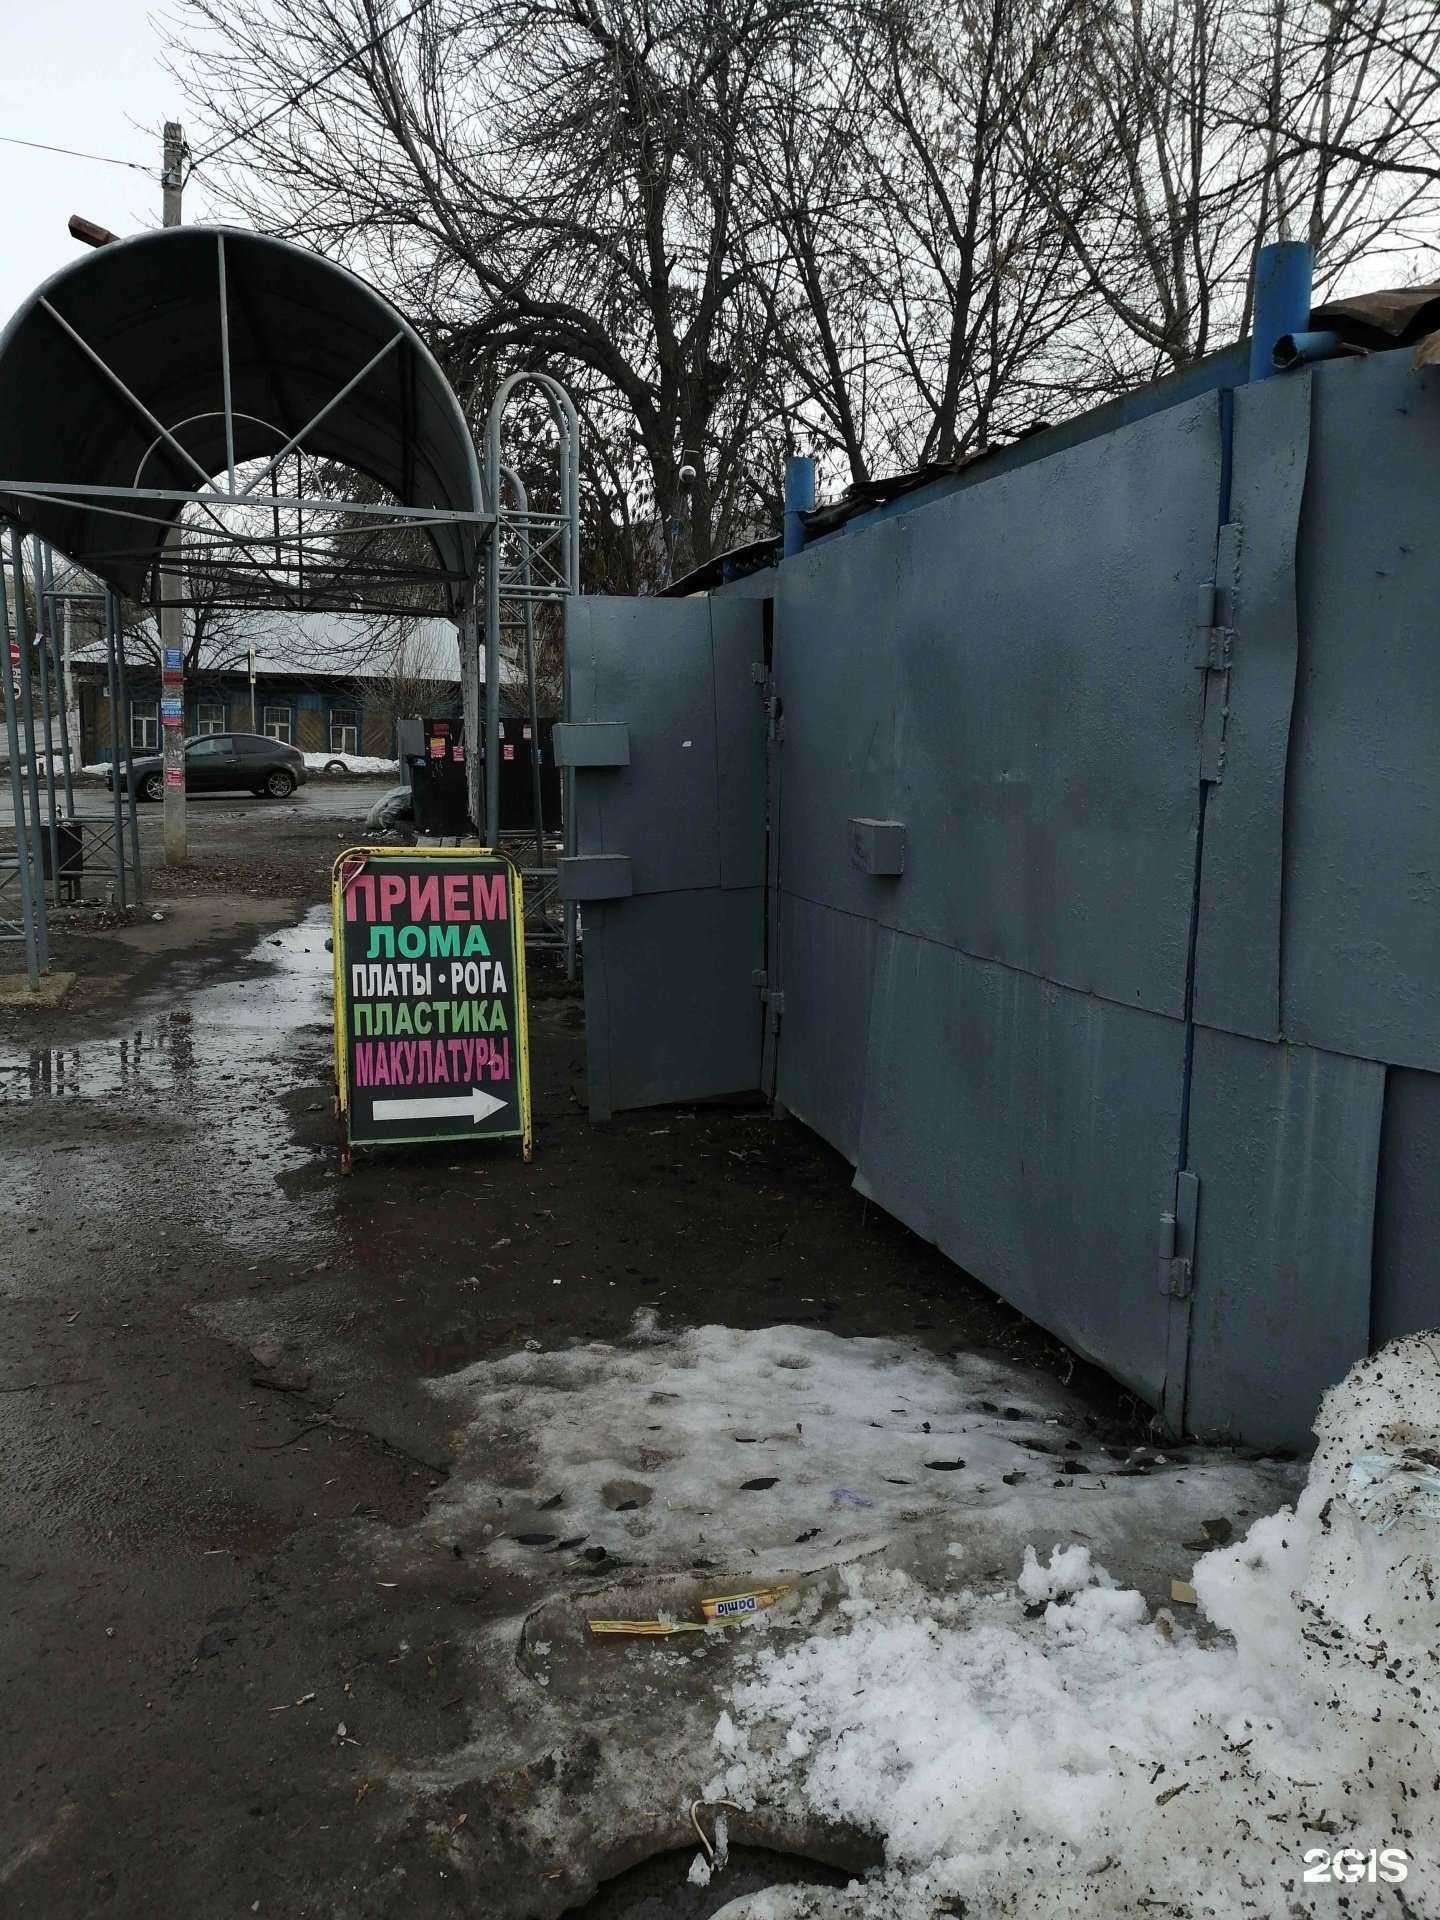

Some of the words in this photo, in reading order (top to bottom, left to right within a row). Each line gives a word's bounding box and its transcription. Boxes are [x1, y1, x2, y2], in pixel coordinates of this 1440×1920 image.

[346, 874, 507, 922] ПРИЕМ
[367, 924, 491, 958] ЛОМА
[352, 963, 431, 997] ПЛАТЫ
[451, 961, 507, 995] РОГА
[353, 1000, 508, 1036] ПЛАСТИКА
[356, 1037, 510, 1087] МАКУЛАТУРЫ
